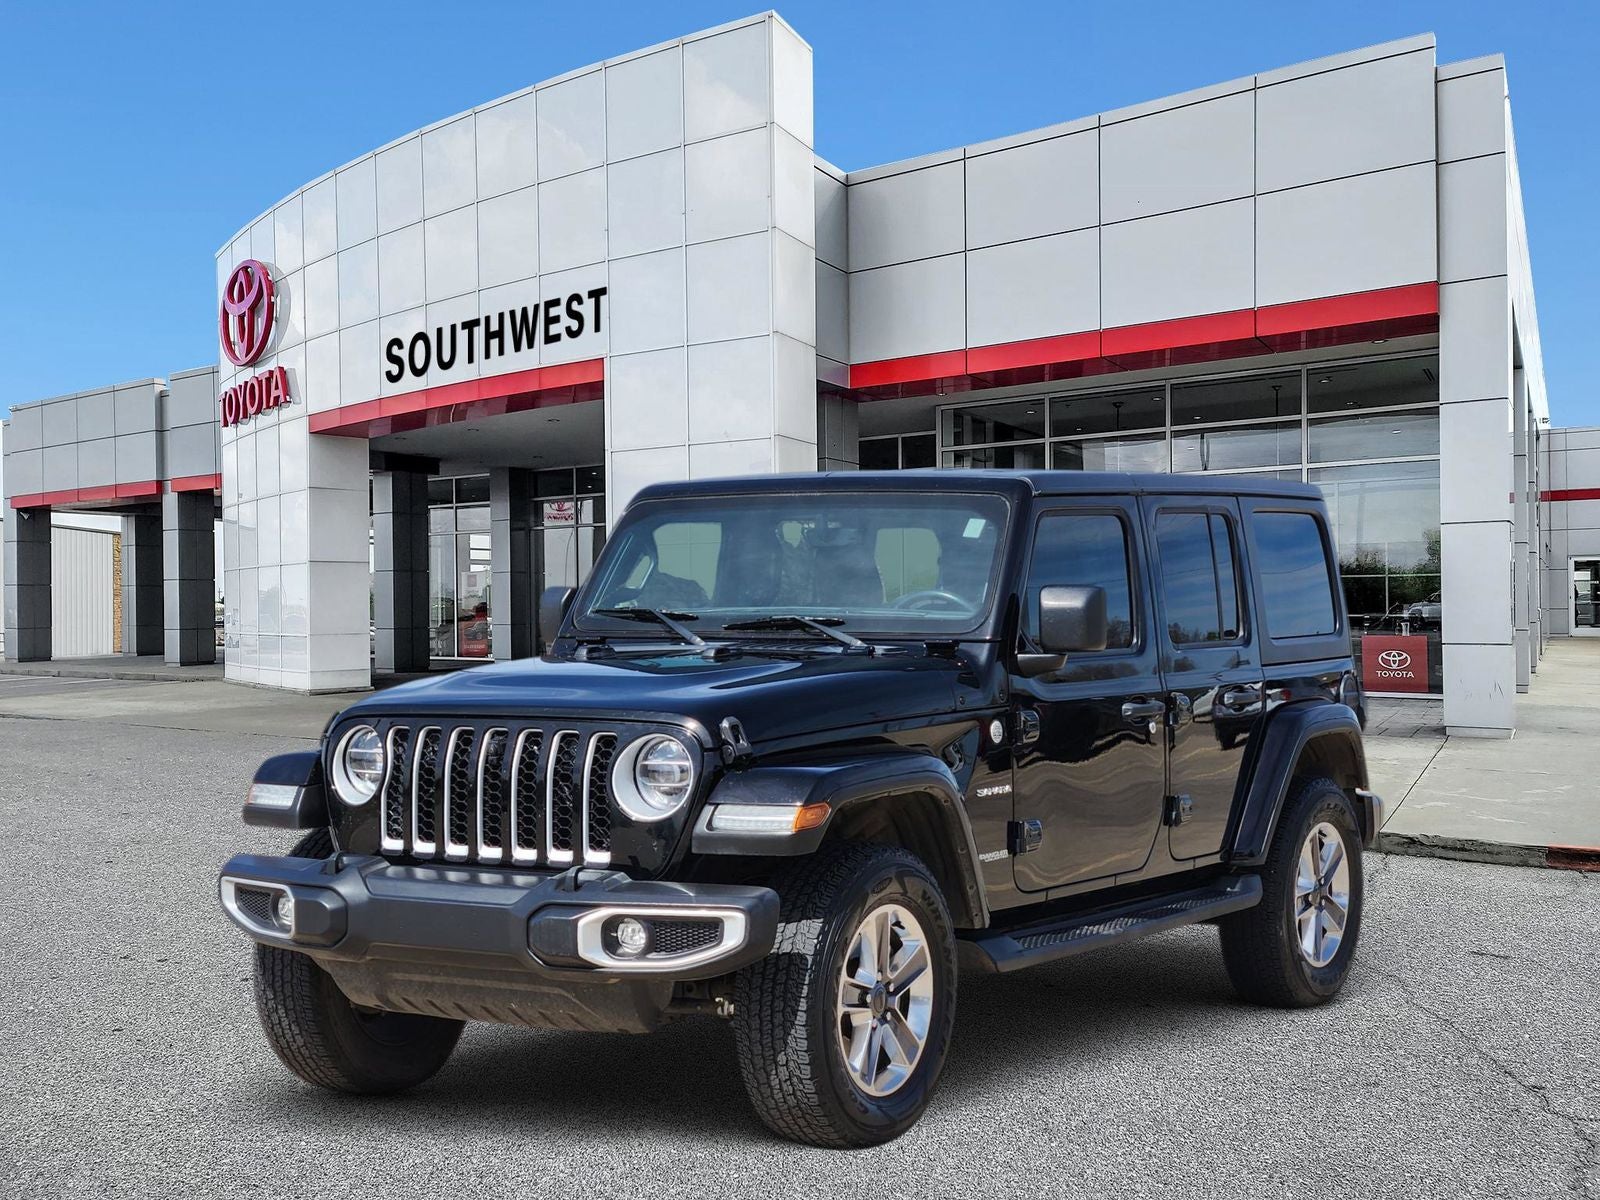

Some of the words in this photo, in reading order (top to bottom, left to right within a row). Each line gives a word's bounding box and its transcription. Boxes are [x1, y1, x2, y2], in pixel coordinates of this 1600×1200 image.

[385, 286, 608, 384] SOUTHWEST
[219, 366, 291, 427] TOYOTA
[1376, 670, 1414, 678] TOYOTA
